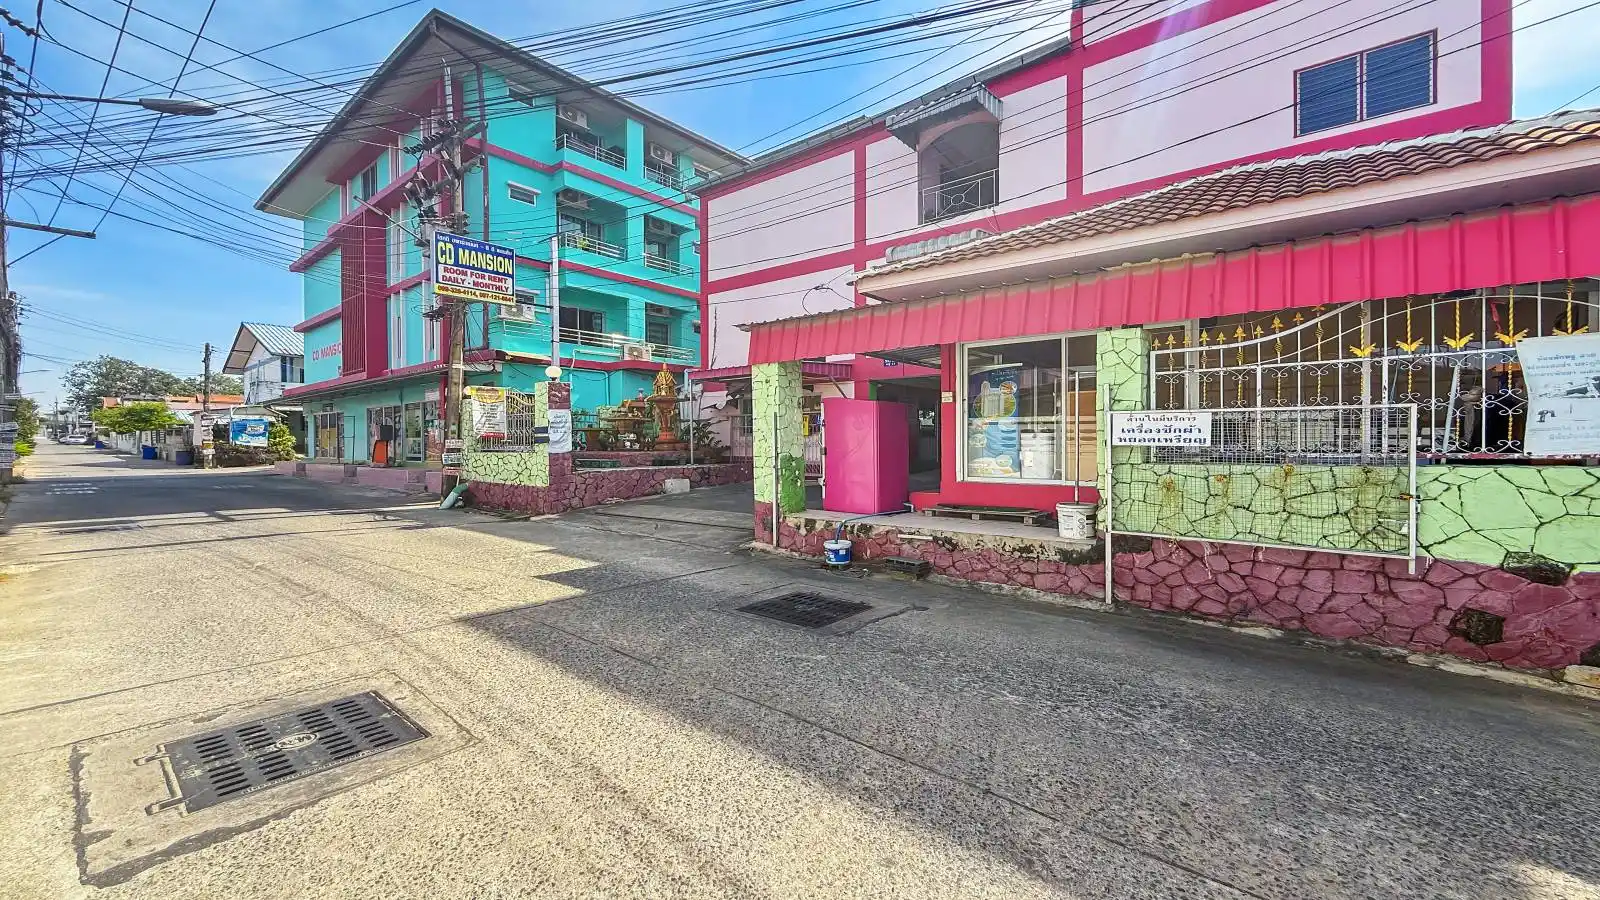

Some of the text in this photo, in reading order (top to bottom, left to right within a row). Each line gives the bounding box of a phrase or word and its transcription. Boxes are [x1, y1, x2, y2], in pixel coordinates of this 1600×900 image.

[438, 242, 513, 274] CD MANSION
[442, 275, 466, 285] DAILY
[472, 280, 510, 292] MONTHLY
[443, 267, 508, 285] ROOM FOR RENT
[1121, 424, 1202, 434] เครื่องซักผ้า
[1117, 435, 1207, 445] หยอดเหรียญ
